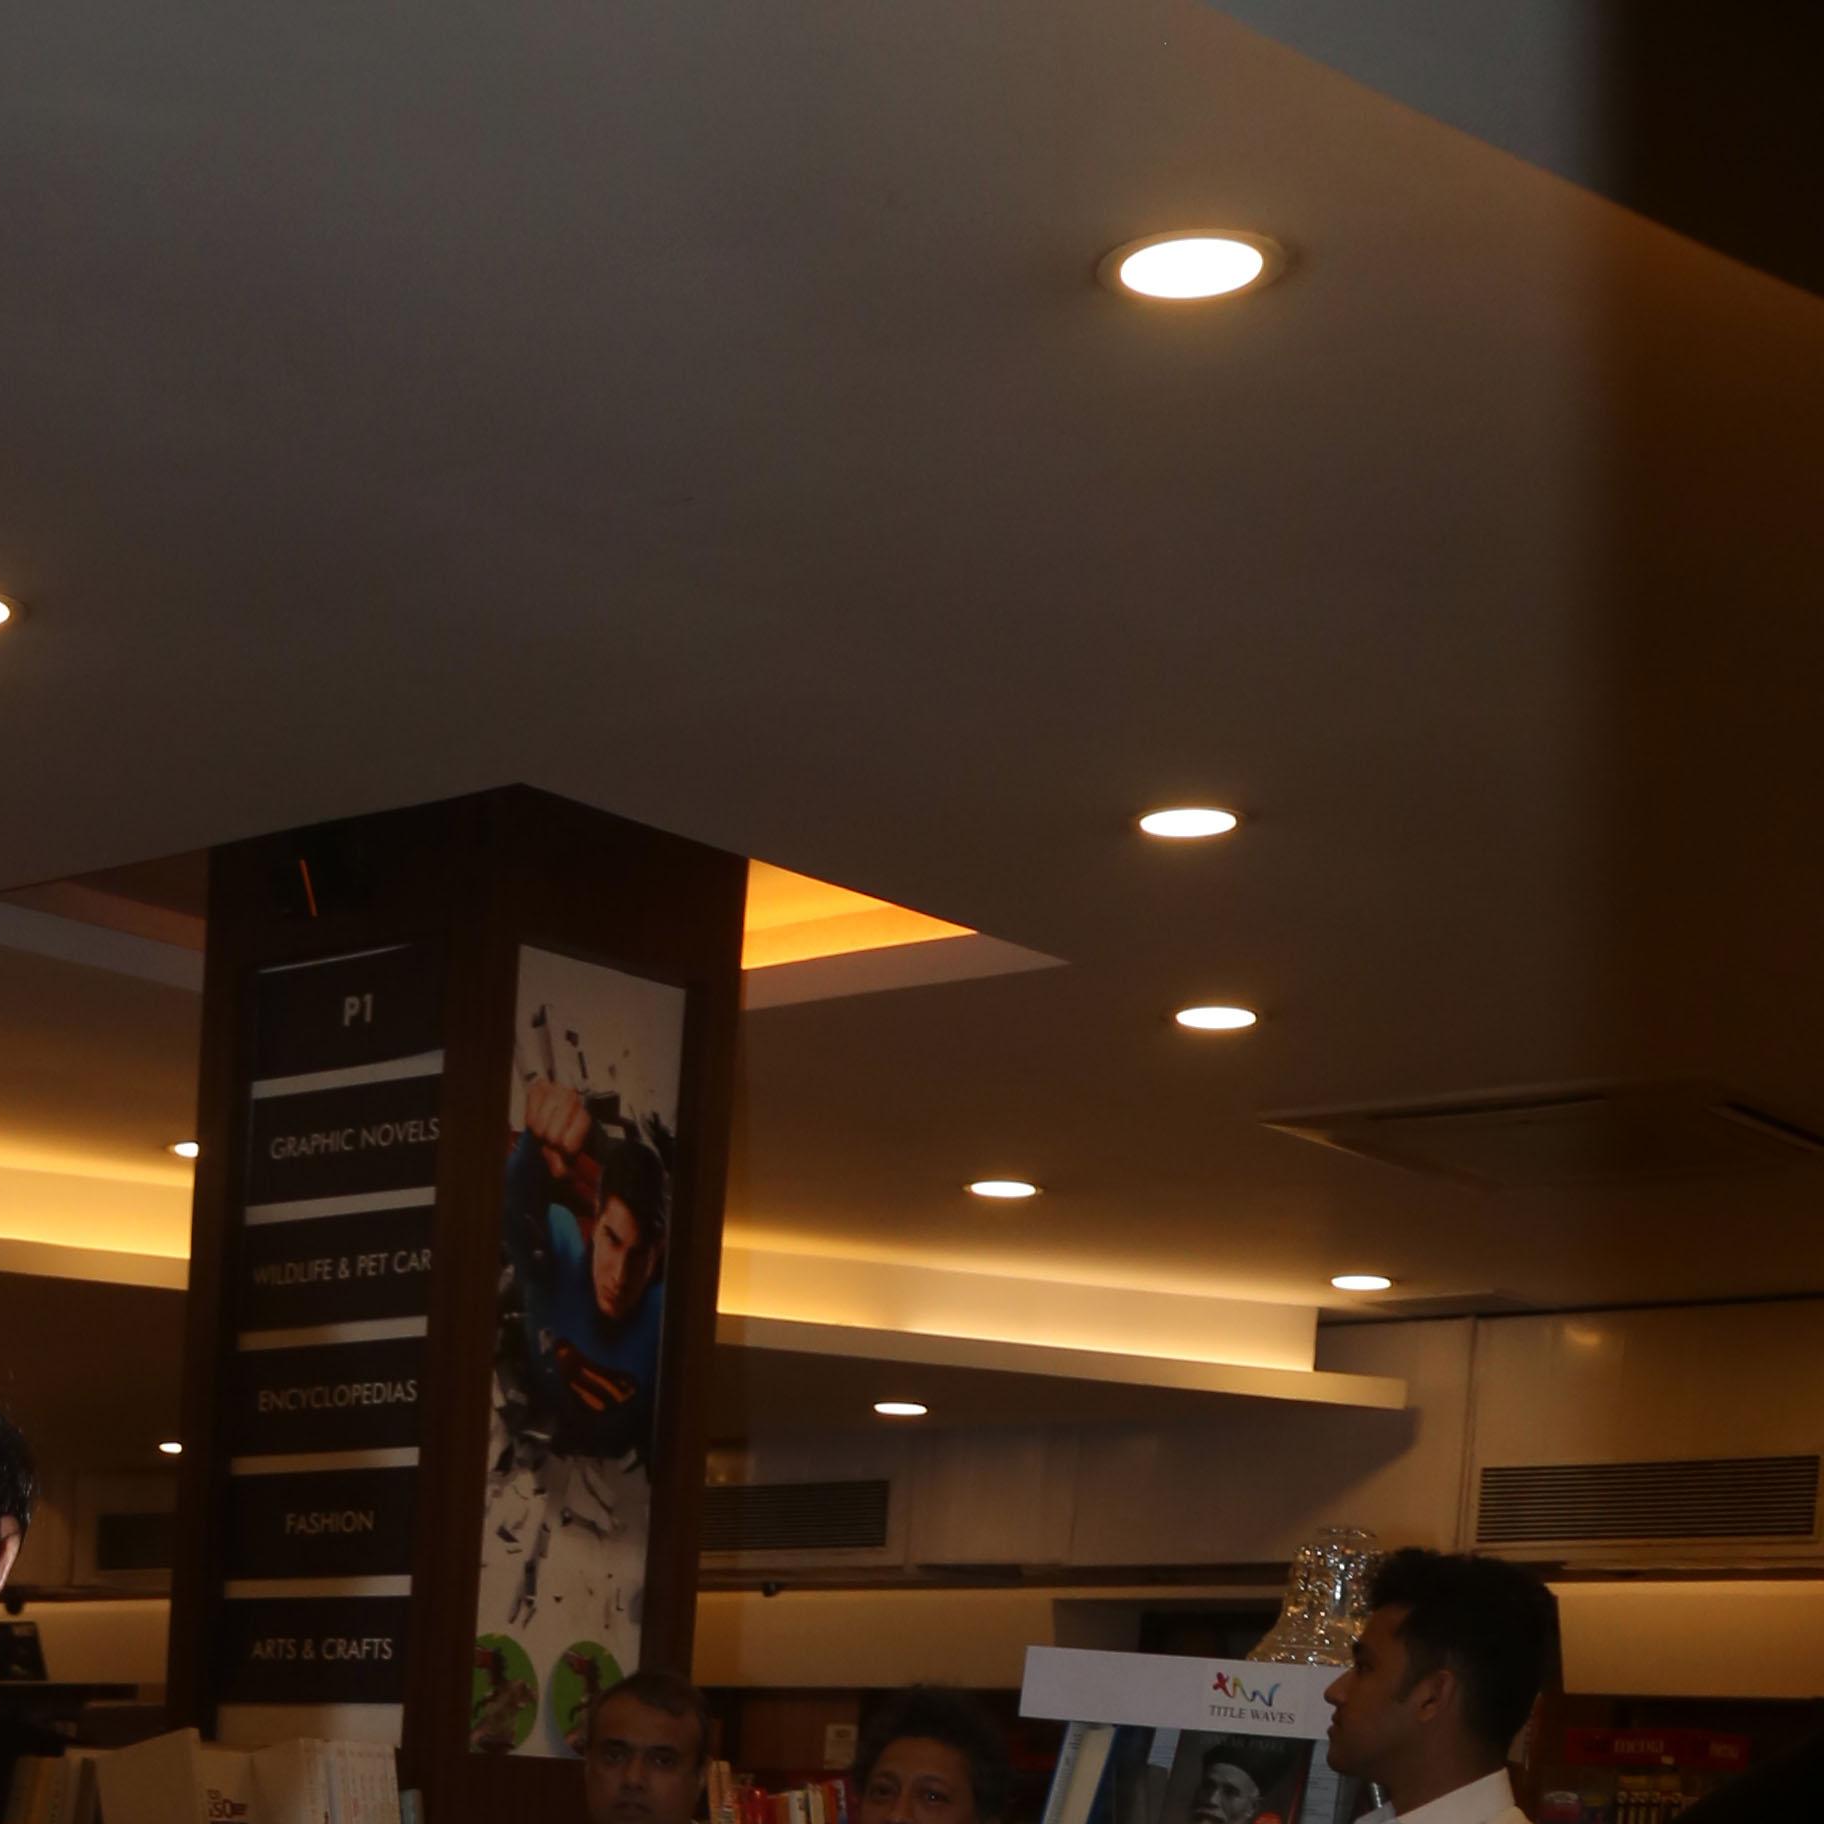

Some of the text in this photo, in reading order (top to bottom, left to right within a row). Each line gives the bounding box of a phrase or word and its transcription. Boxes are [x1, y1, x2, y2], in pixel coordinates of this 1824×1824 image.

[342, 992, 375, 1028] P1
[269, 1117, 441, 1160] GRAPHIC NOVELS
[253, 1256, 333, 1287] WILDLIFE
[336, 1256, 351, 1280] &
[356, 1253, 389, 1277] PET
[256, 1379, 419, 1413] ENCYCLOPEDIAS
[284, 1509, 375, 1535] FASHION
[250, 1637, 394, 1661] ARTS & CRAFTS
[1208, 1704, 1296, 1724] TITLE WAVES
